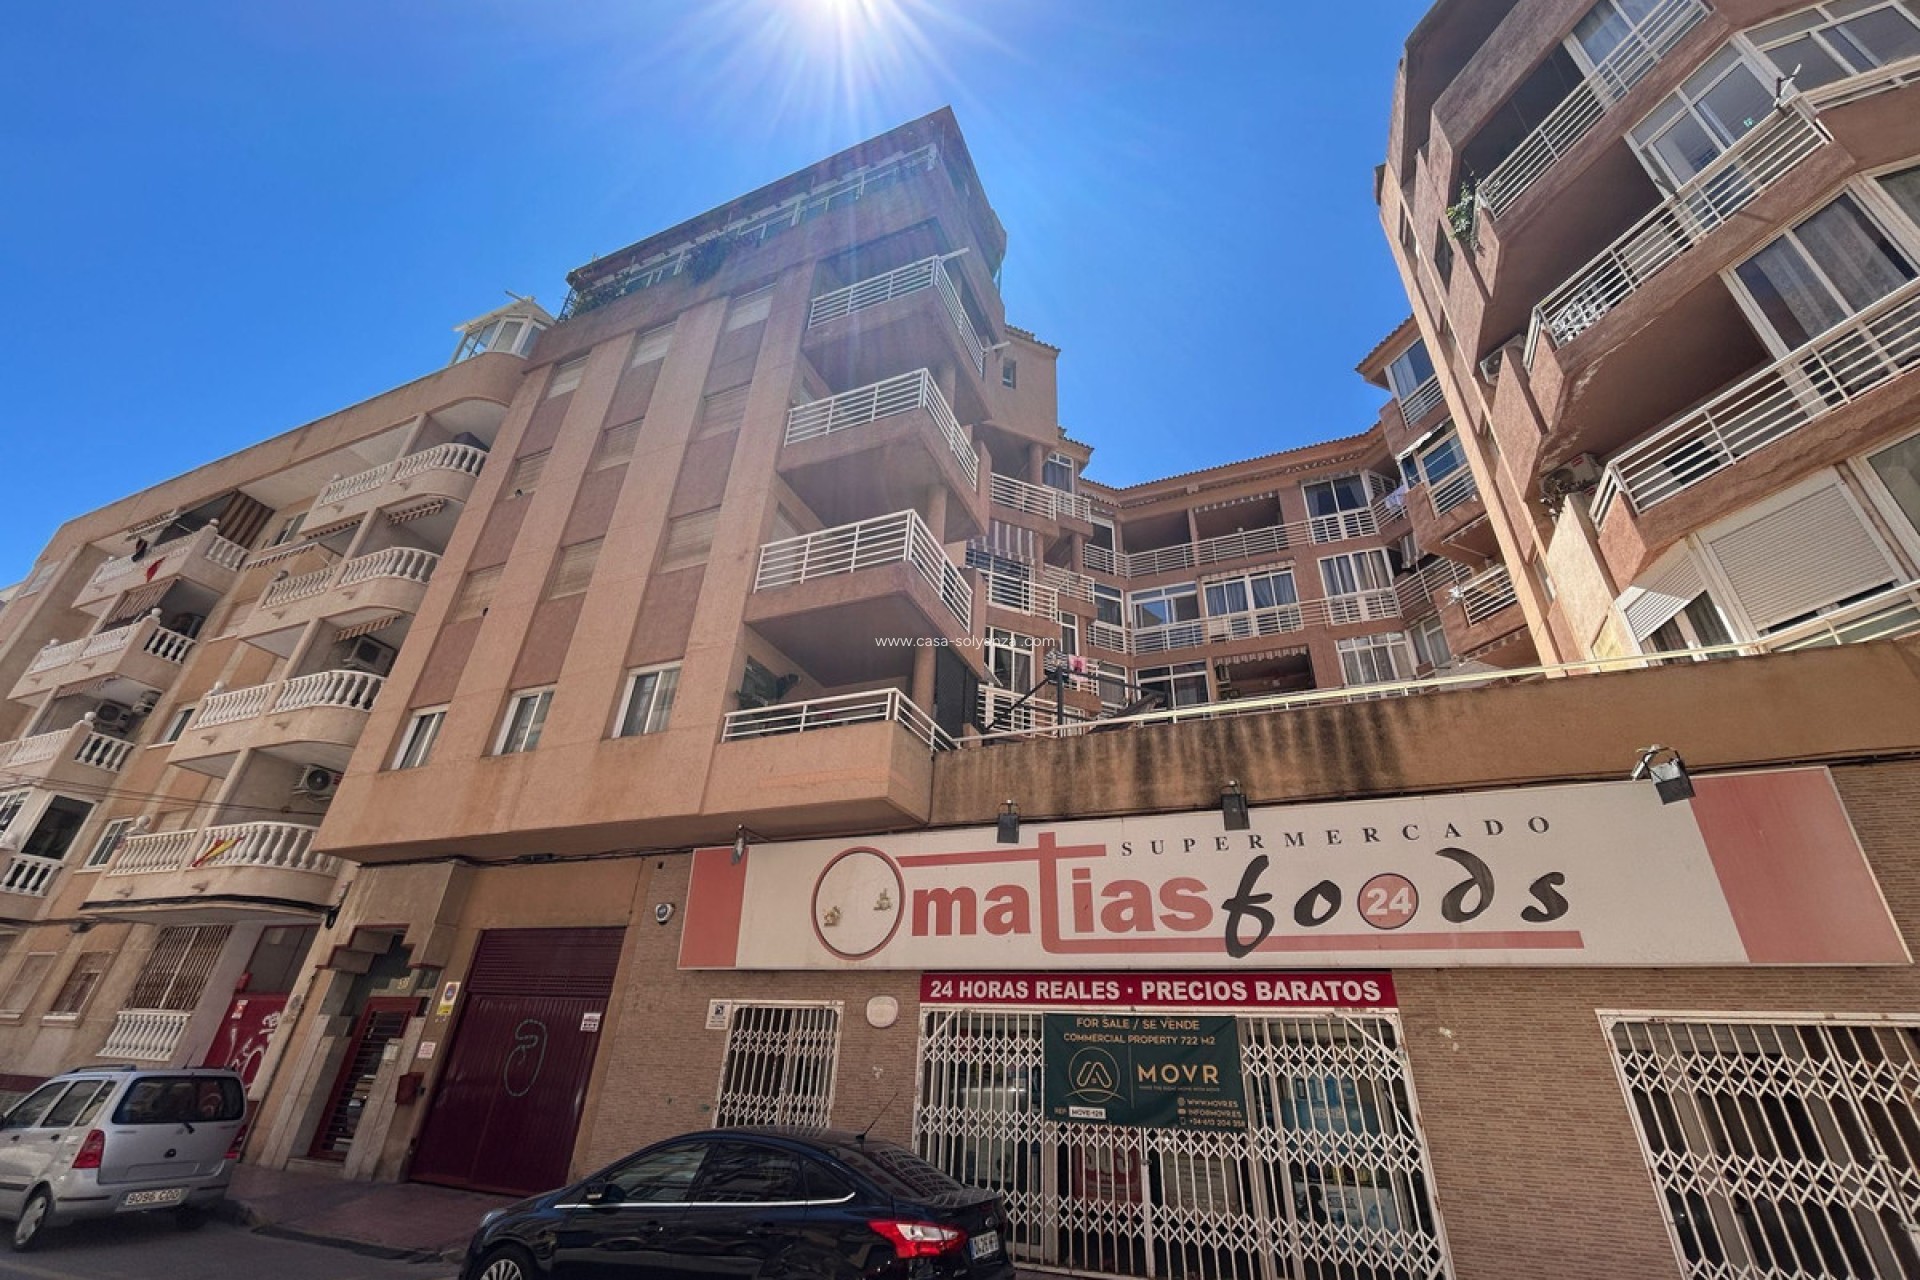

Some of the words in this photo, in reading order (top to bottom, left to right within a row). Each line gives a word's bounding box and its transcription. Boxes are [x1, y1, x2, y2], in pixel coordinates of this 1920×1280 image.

[1120, 815, 1551, 858] SUPERMERCADO
[1366, 886, 1412, 916] 24
[930, 980, 953, 998] 24
[959, 980, 1029, 999] HORAS
[1035, 980, 1120, 1000] REALES
[1141, 981, 1248, 1001] PRECIOS
[1254, 981, 1382, 1002] BARATOS
[1076, 1017, 1100, 1028] FOR
[1102, 1018, 1130, 1029] SALE
[1142, 1019, 1158, 1030] SE
[1160, 1019, 1200, 1031] VENDE
[1063, 1033, 1126, 1044] COMMERCIAL
[1127, 1035, 1178, 1046] PROPERTY
[1180, 1036, 1199, 1046] 722
[1201, 1037, 1216, 1046] M2
[1136, 1063, 1220, 1085] MOVR
